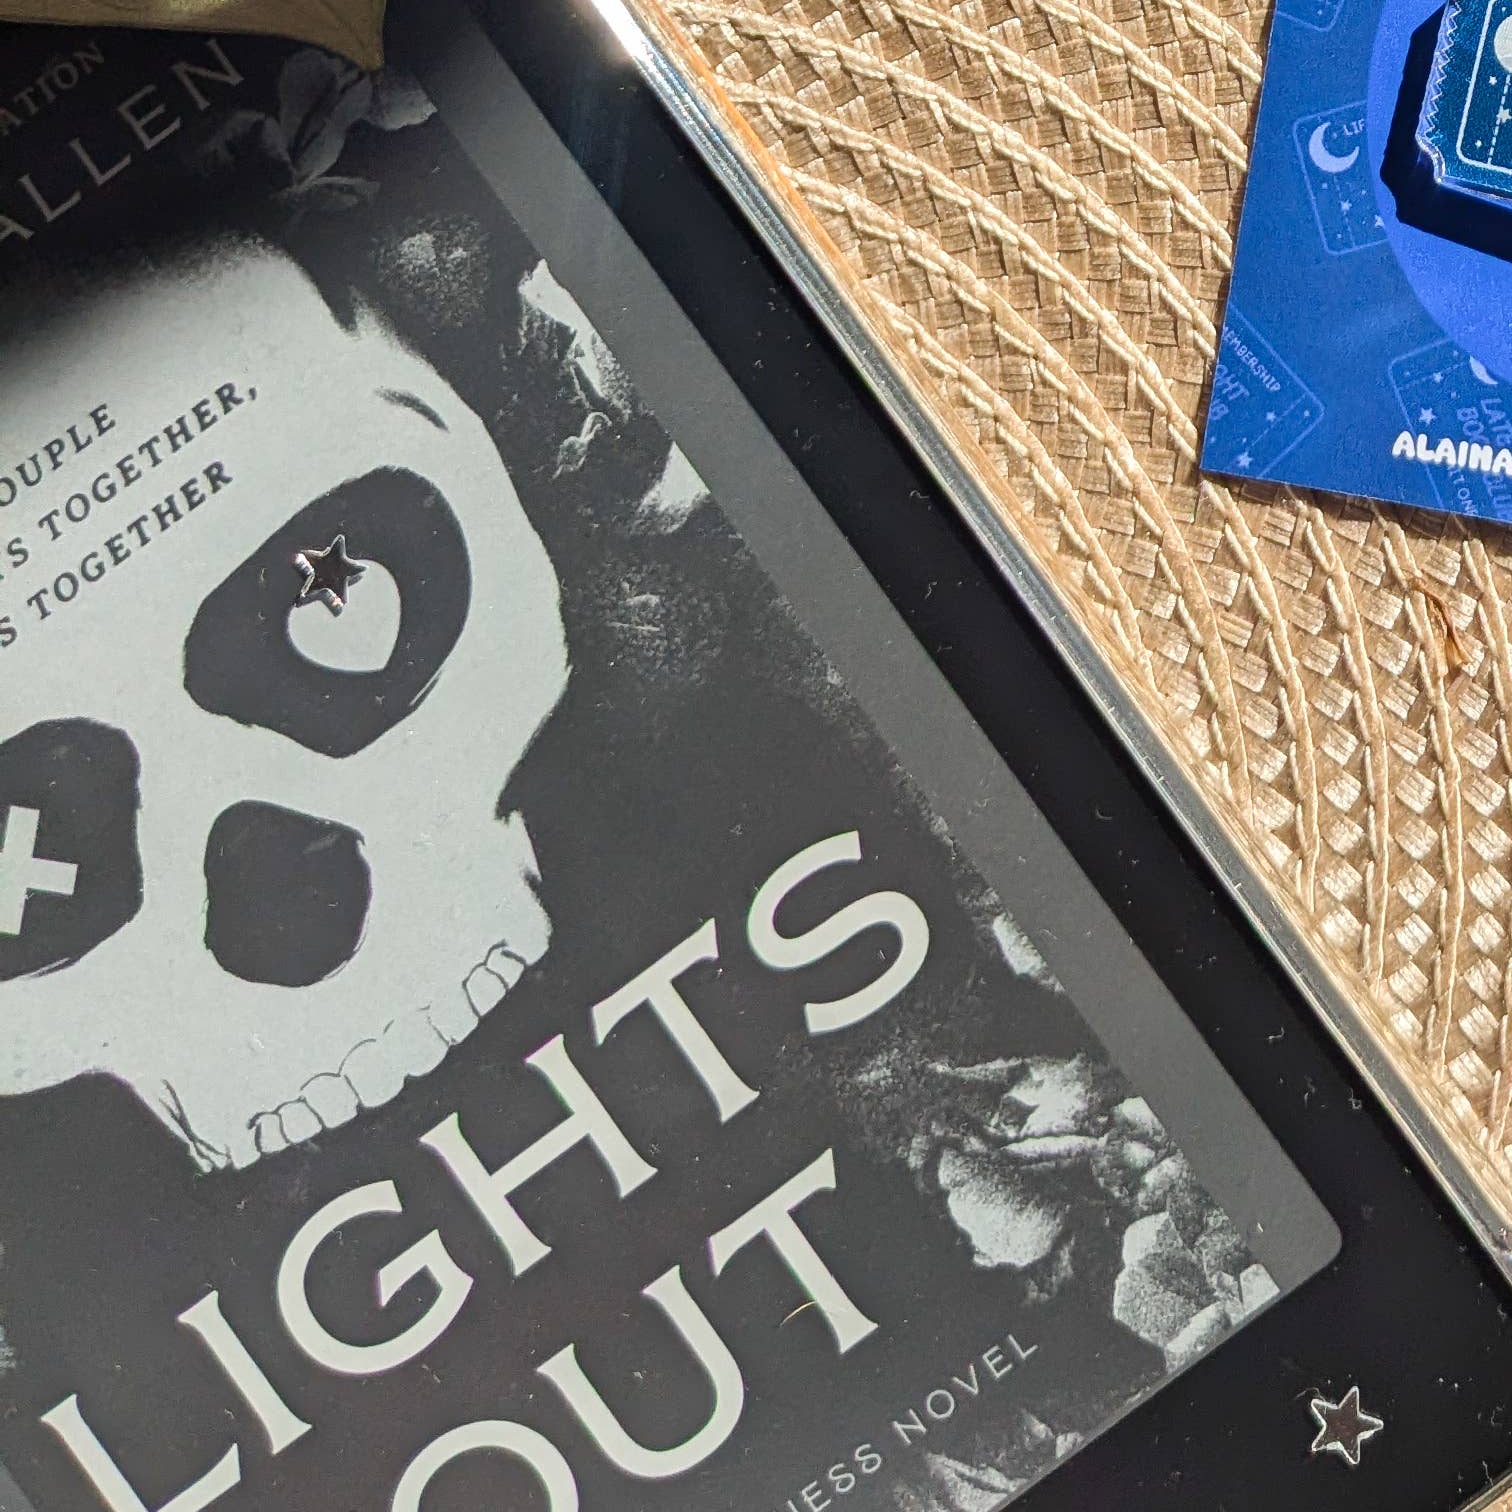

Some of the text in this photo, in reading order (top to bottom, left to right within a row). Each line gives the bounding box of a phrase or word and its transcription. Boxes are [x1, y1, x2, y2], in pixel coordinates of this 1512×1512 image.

[26, 461, 233, 620] TOGETHER
[38, 382, 258, 541] TOGETHER,
[41, 830, 930, 1512] LIGHTS
[892, 1334, 1039, 1446] NOVEL
